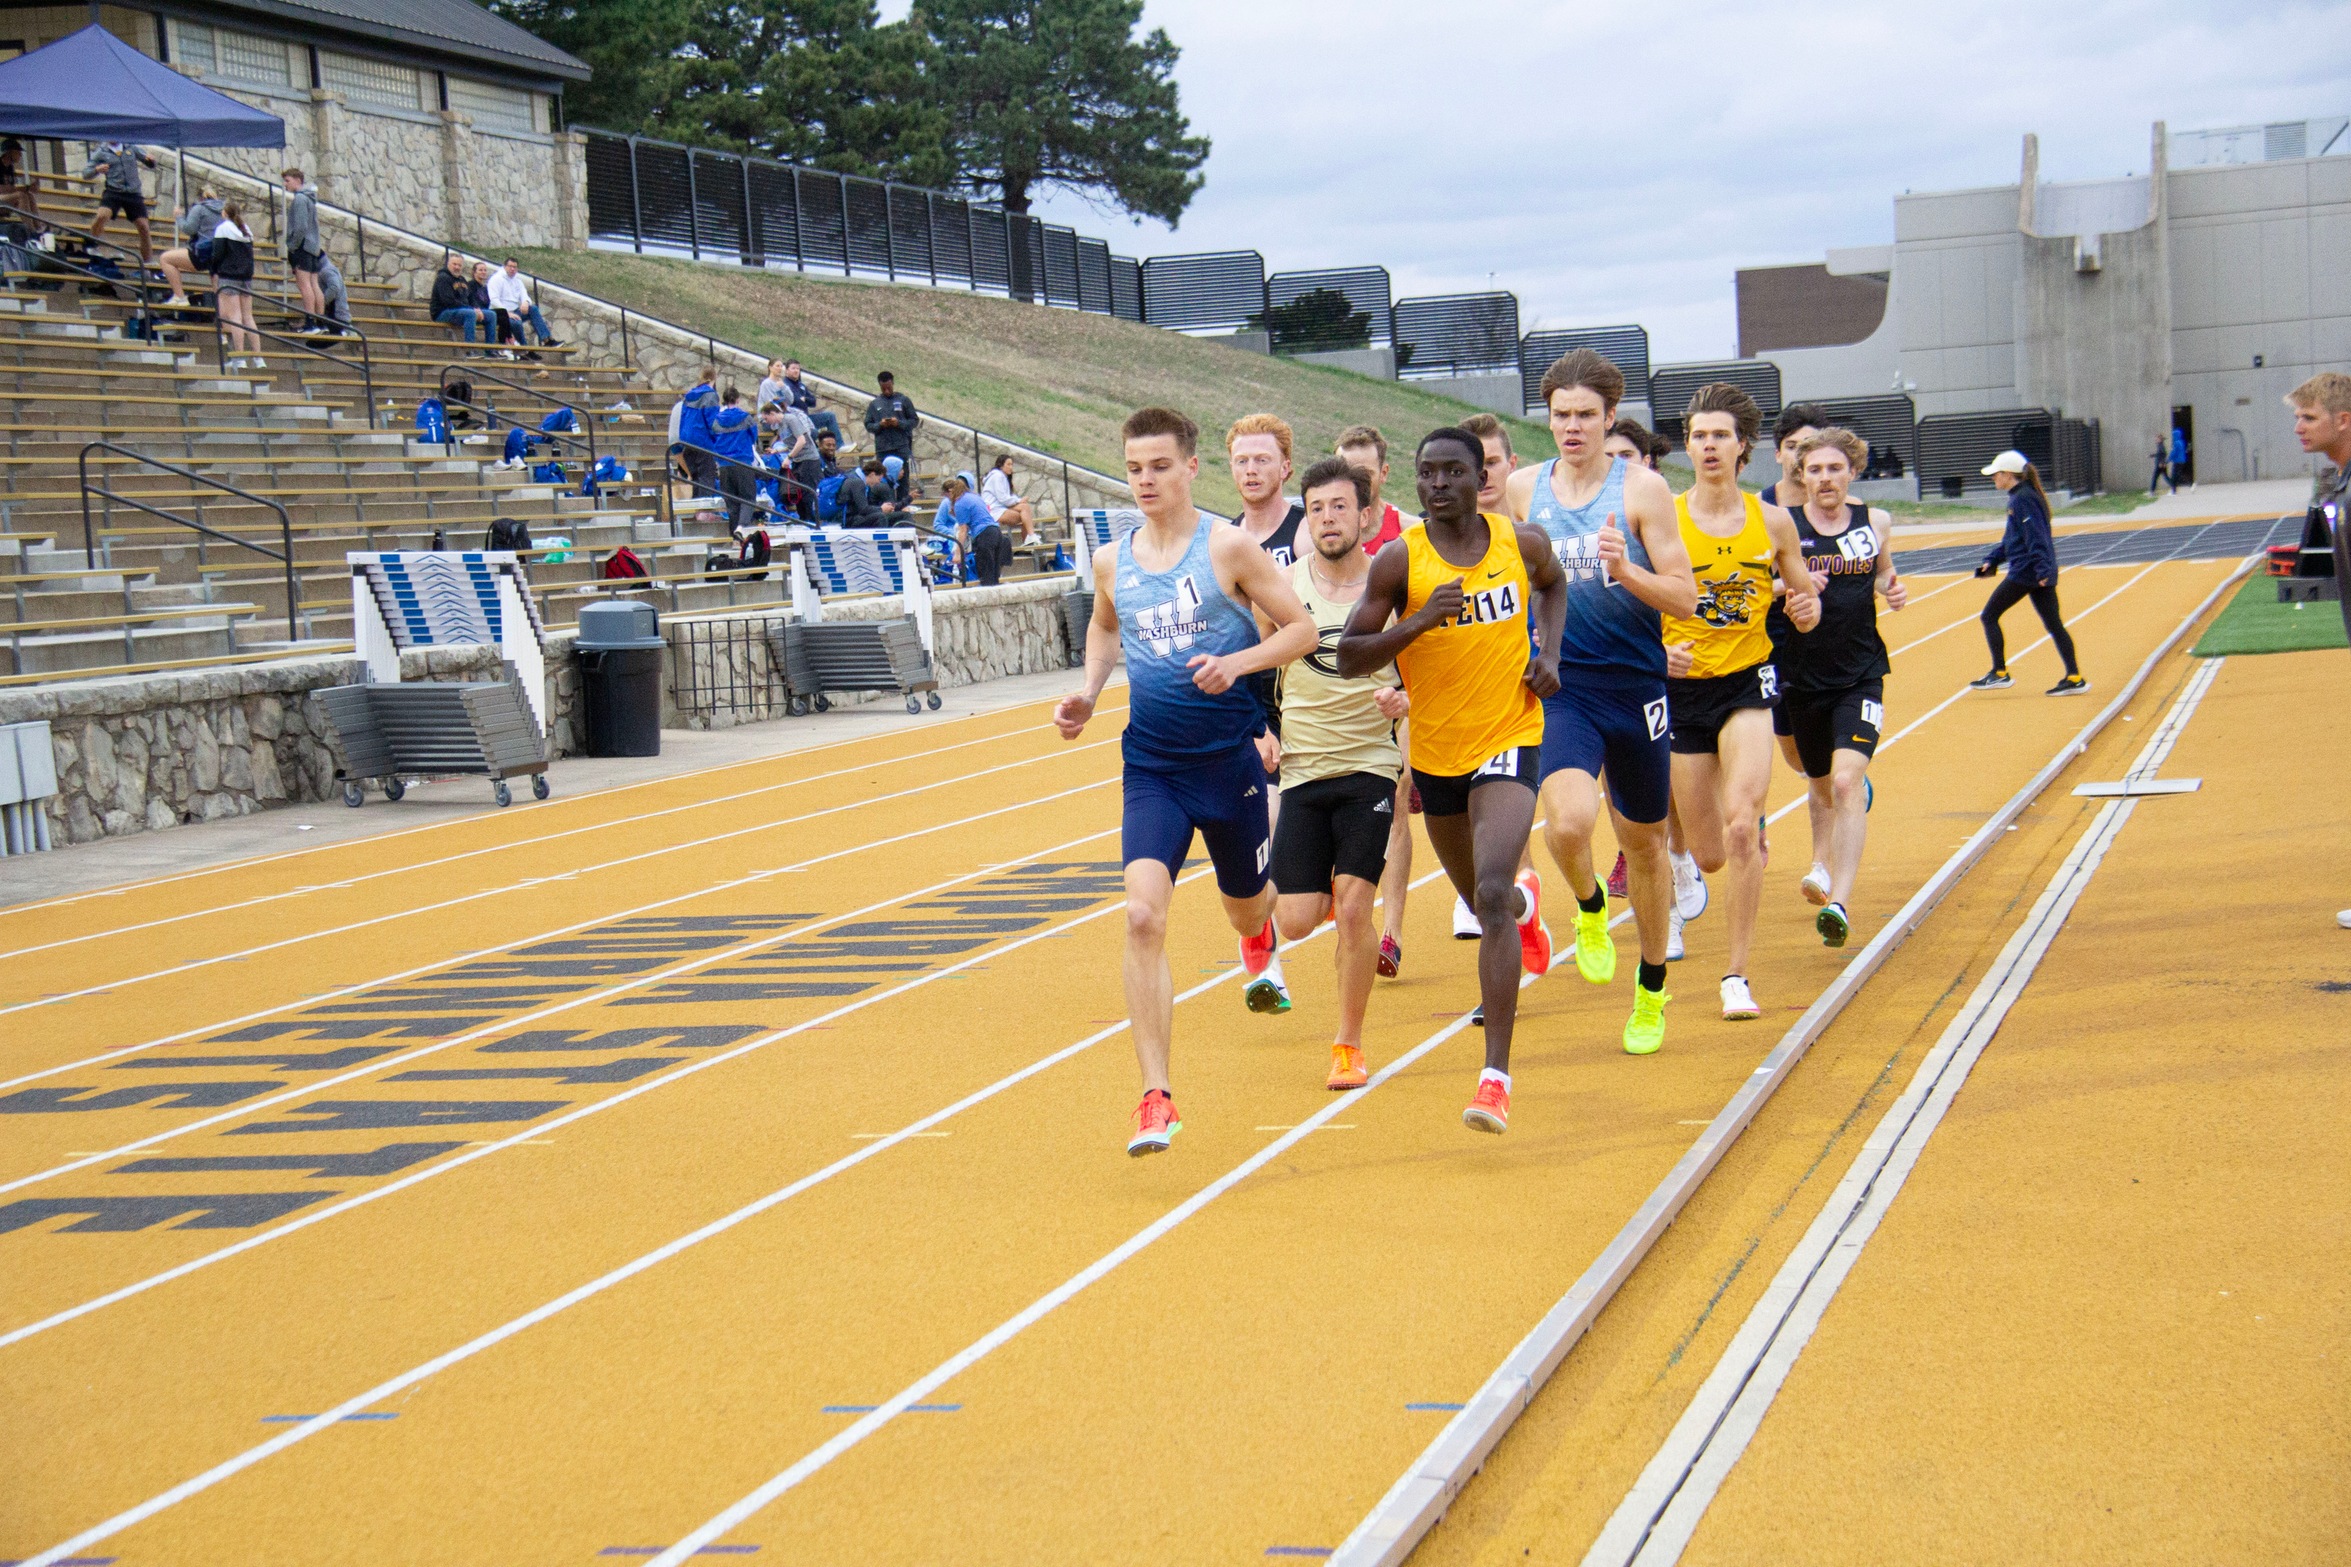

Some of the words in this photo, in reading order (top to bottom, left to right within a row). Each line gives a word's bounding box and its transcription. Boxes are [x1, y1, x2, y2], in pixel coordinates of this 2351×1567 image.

[1842, 531, 1874, 559] 13
[1559, 558, 1601, 569] SHBUR
[1803, 553, 1875, 576] OYOTES
[1183, 576, 1199, 605] 1
[1480, 586, 1516, 622] 14
[1136, 620, 1209, 642] WASHBURN
[1648, 702, 1666, 737] 2
[0, 912, 821, 1114] HORNETS
[0, 1024, 768, 1235] STATE
